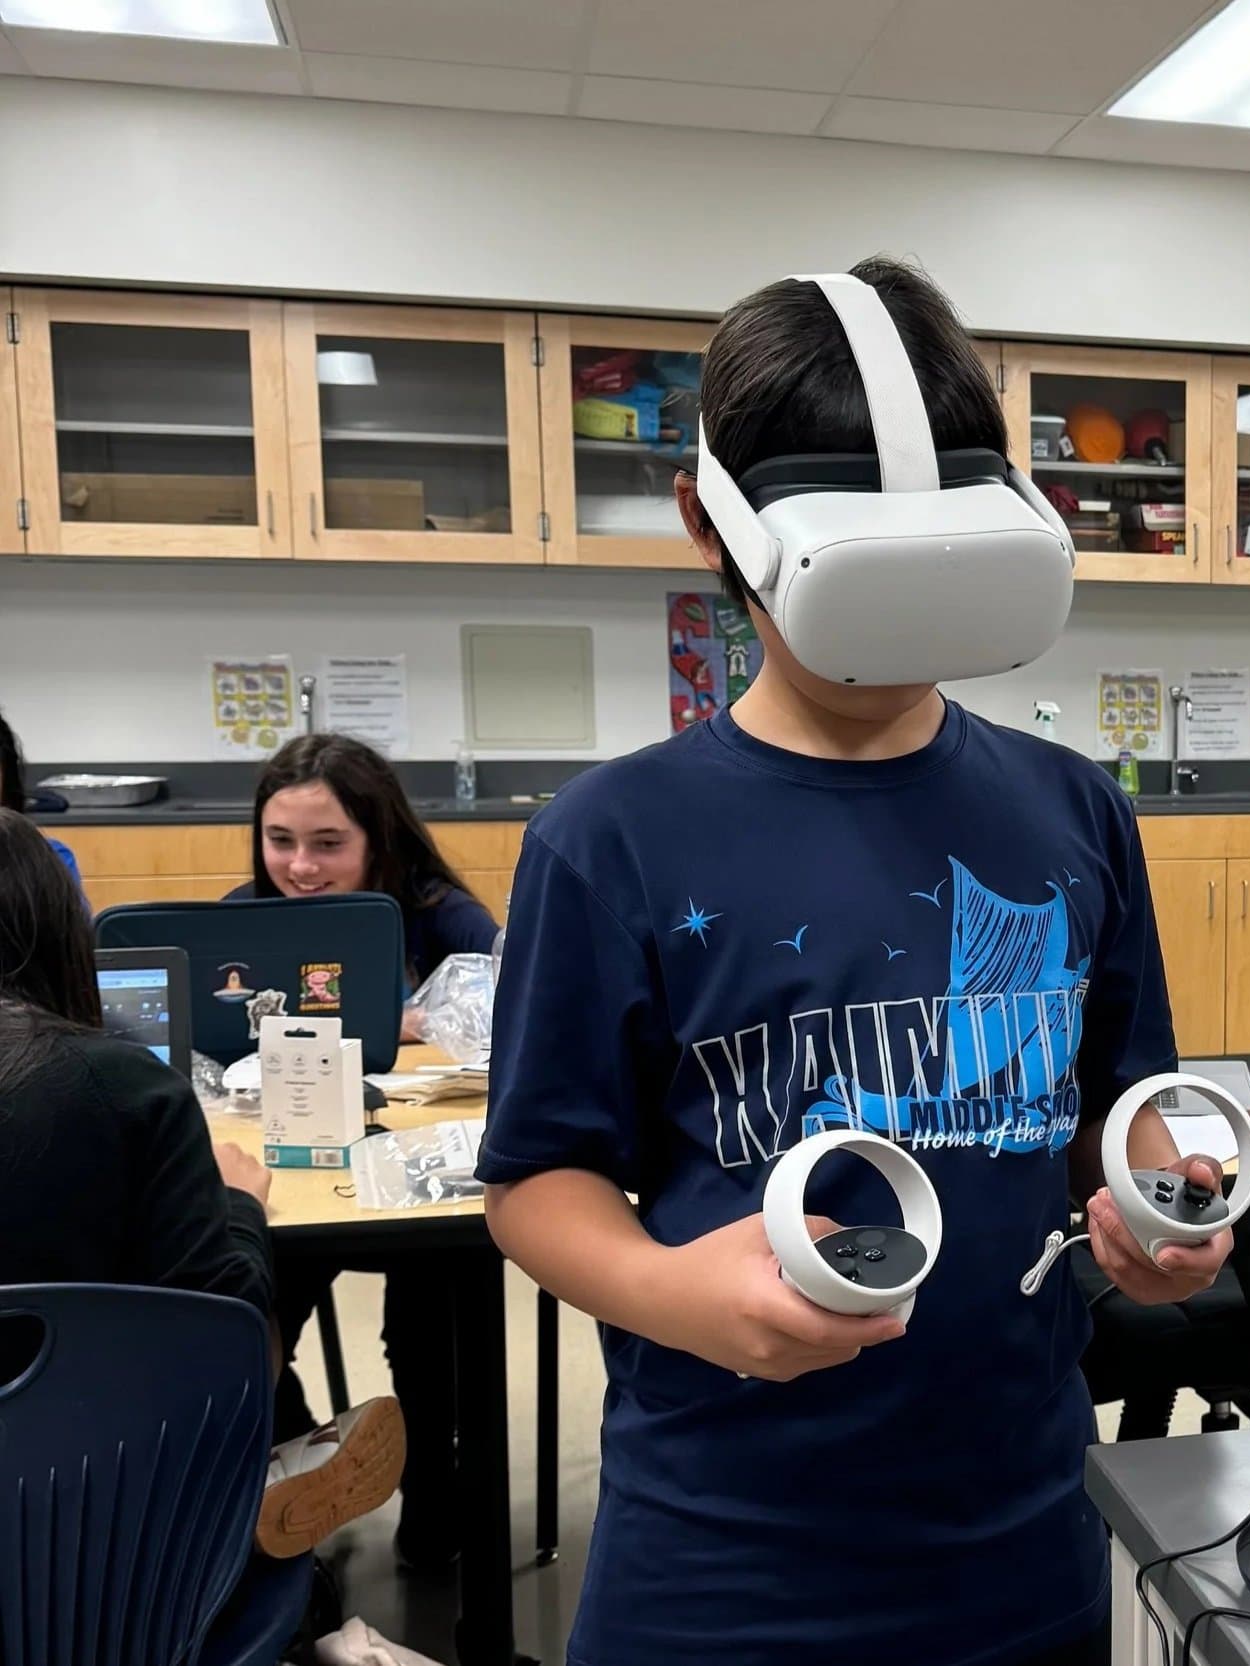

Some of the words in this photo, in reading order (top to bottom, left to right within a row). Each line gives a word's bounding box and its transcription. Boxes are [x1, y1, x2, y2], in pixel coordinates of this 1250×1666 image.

[909, 1094, 1028, 1137] MIDDLE
[912, 1127, 976, 1151] Home
[983, 1116, 1012, 1158] of
[1014, 1116, 1046, 1143] the
